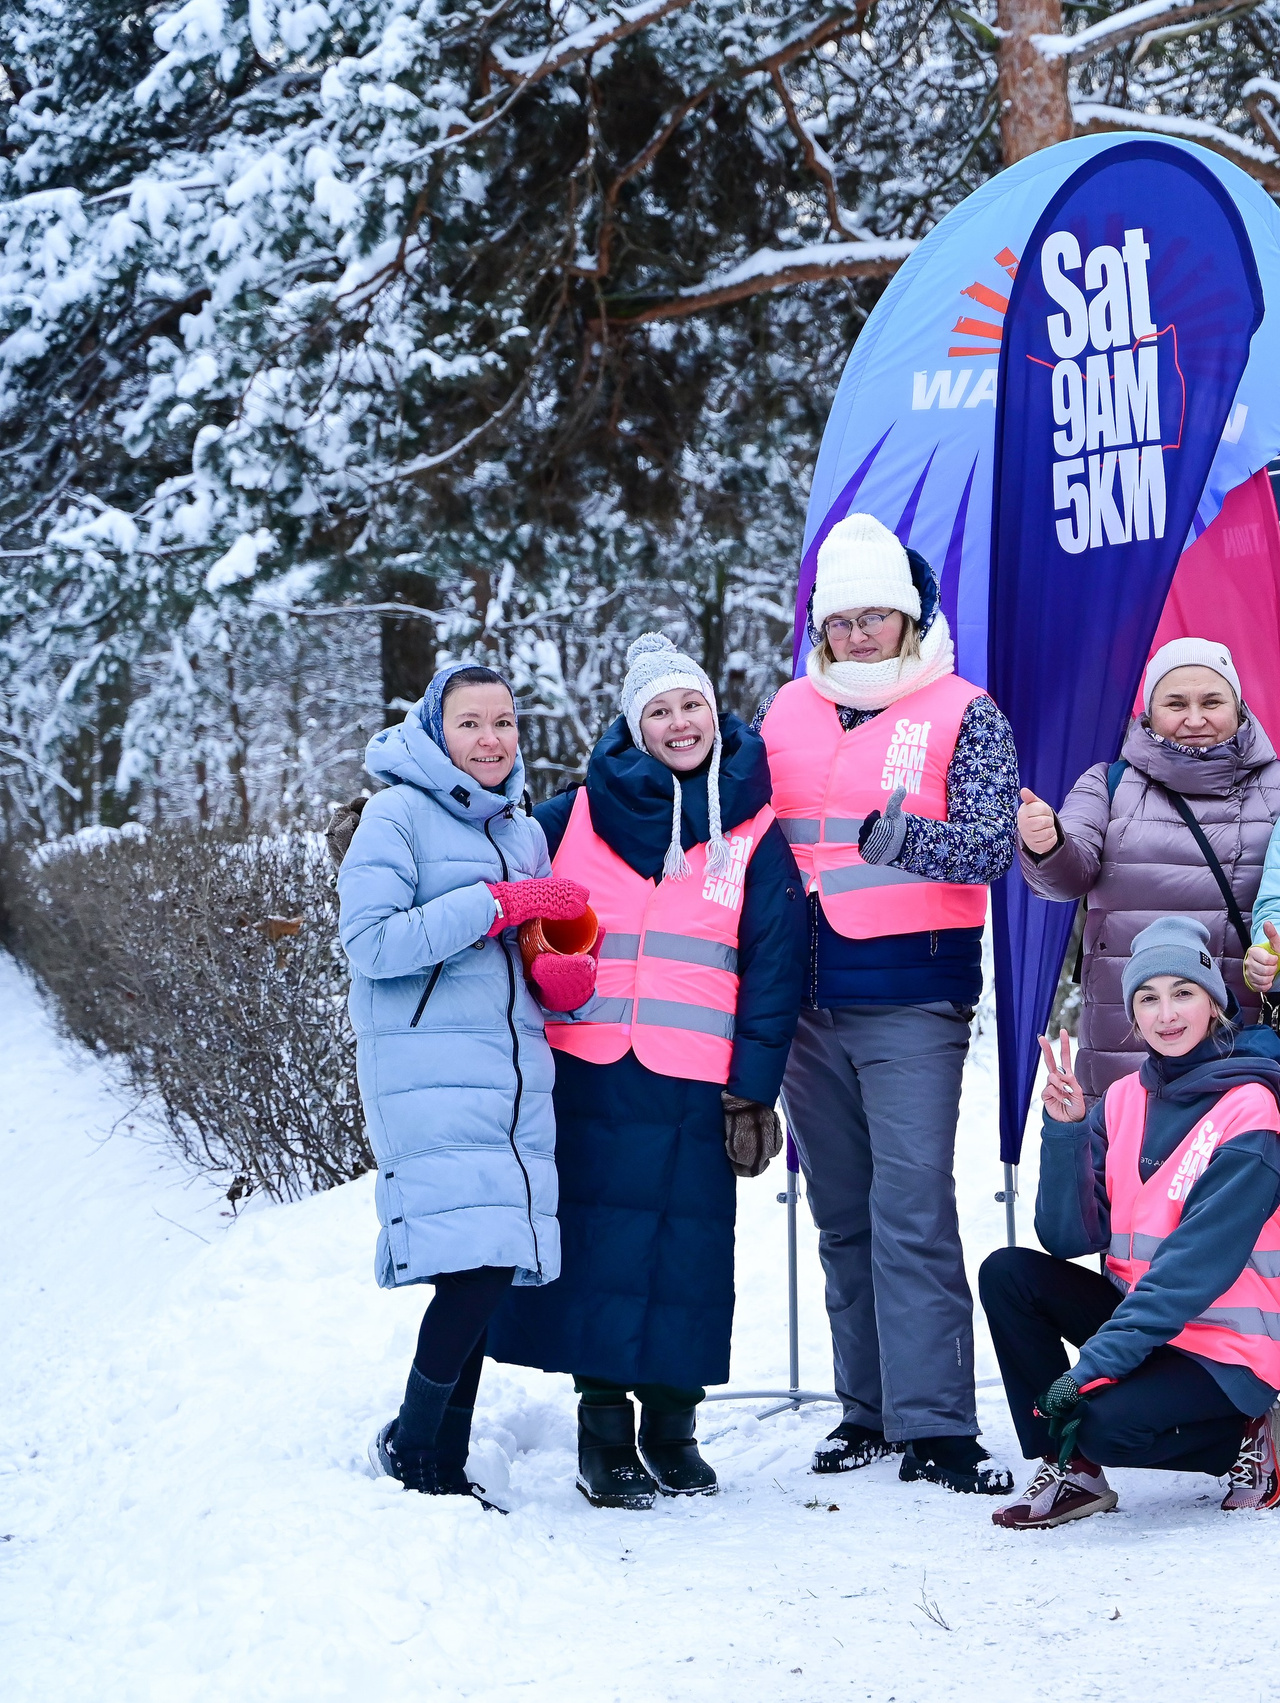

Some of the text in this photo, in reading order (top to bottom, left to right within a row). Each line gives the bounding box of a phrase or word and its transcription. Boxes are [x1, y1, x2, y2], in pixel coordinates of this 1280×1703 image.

[1041, 228, 1158, 359] Sat
[1051, 345, 1161, 457] 9AM
[1052, 444, 1167, 555] 5KM
[891, 718, 932, 748] Sat
[884, 743, 927, 771] 9AM
[880, 766, 923, 795] 5KM
[726, 832, 754, 866] at
[702, 876, 741, 911] 5KM
[1190, 1119, 1224, 1160] Sa
